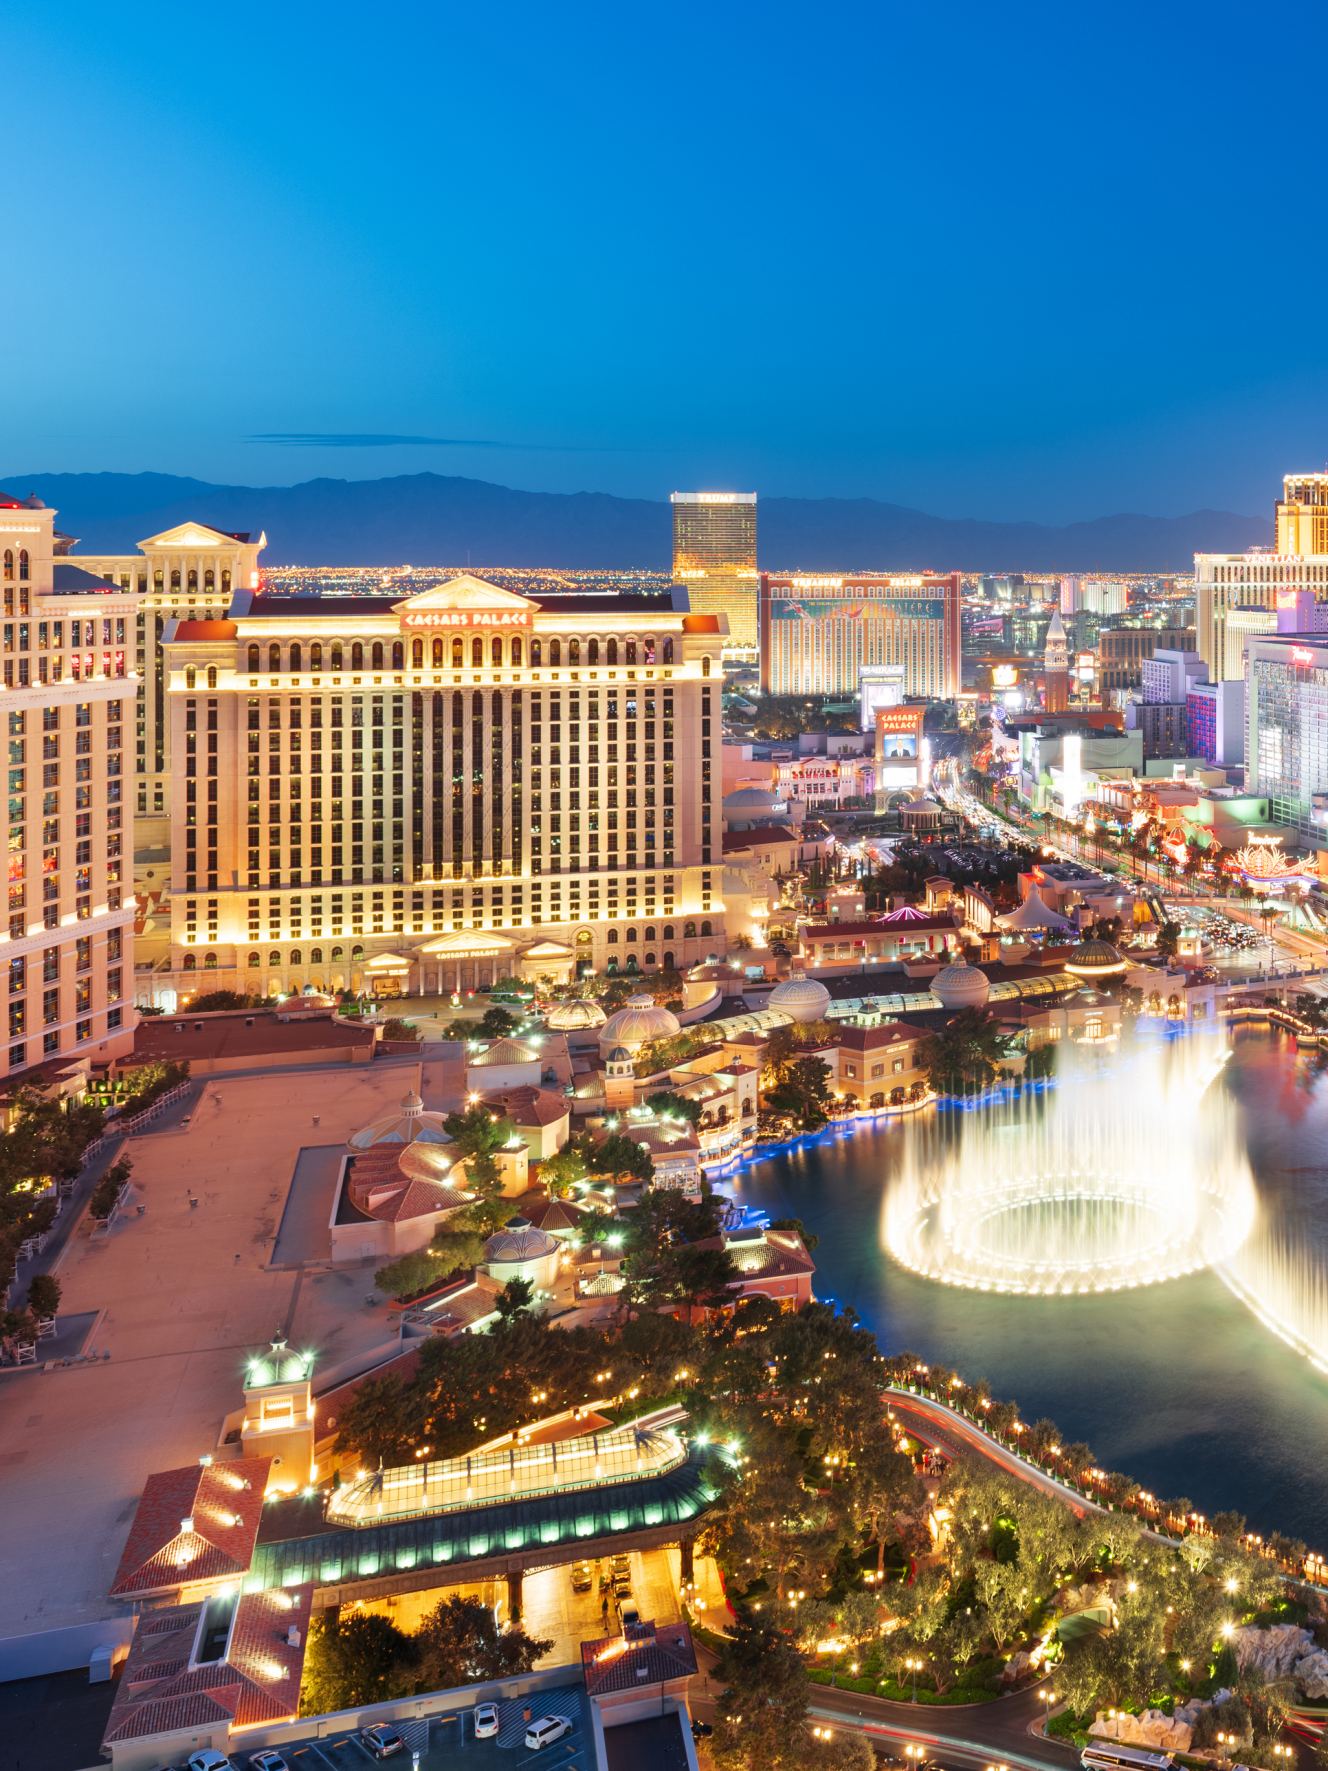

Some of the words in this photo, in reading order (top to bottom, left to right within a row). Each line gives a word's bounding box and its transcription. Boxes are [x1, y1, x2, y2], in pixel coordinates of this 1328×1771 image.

[1244, 555, 1301, 563] VENETIAN
[405, 614, 469, 625] CAESARS
[472, 612, 527, 625] PALACE
[881, 714, 918, 722] CAESARS
[883, 721, 916, 729] PALACE
[436, 951, 469, 960] CAESARS
[470, 949, 500, 958] PALACE
